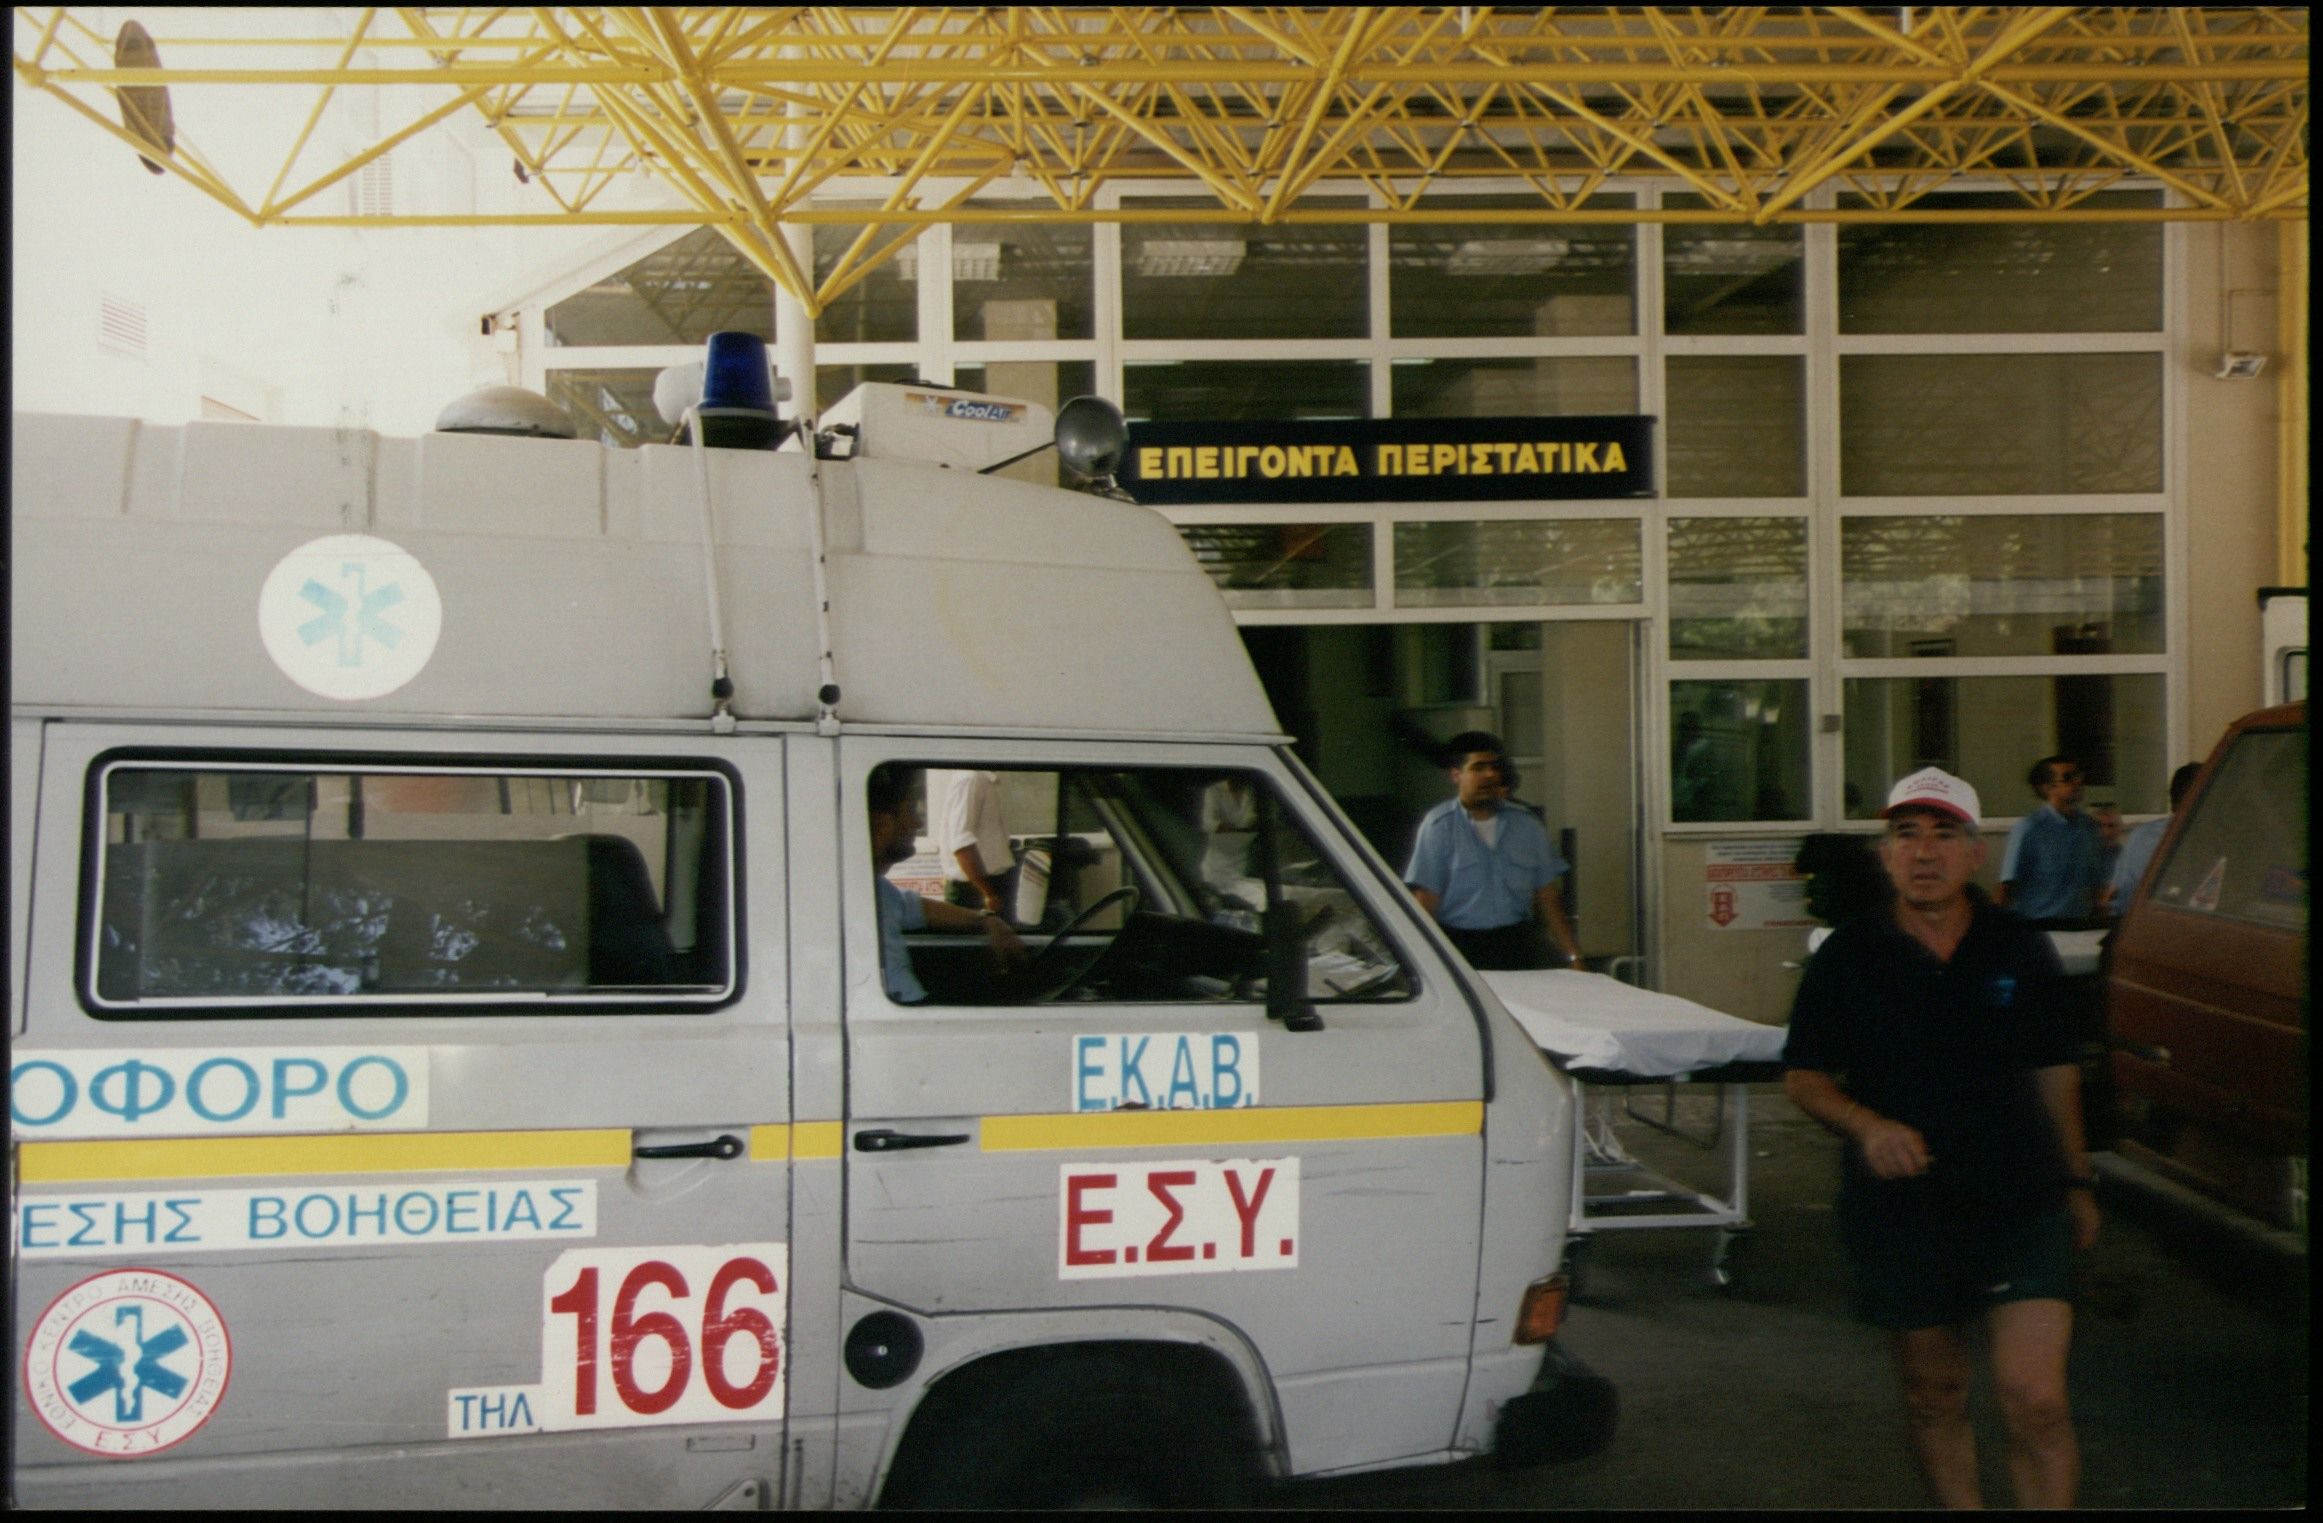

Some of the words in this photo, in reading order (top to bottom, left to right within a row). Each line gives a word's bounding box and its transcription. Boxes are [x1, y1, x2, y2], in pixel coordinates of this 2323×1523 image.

[1138, 445, 1359, 480] ΕΠΕΙΓΟΝΤΑ
[1377, 441, 1628, 477] ΠΕΡΙΣΤΑΤΙΚΑ
[1078, 1034, 1253, 1111] Ε.Κ.Α.Β.
[21, 1198, 202, 1248] ΕΣΗΣ
[248, 1188, 583, 1240] ΒΟΗΘΕΙΑΣ
[1066, 1168, 1294, 1266] Ε.Σ.Υ.
[551, 1256, 780, 1416] 166
[455, 1393, 535, 1431] ΤΗΛ
